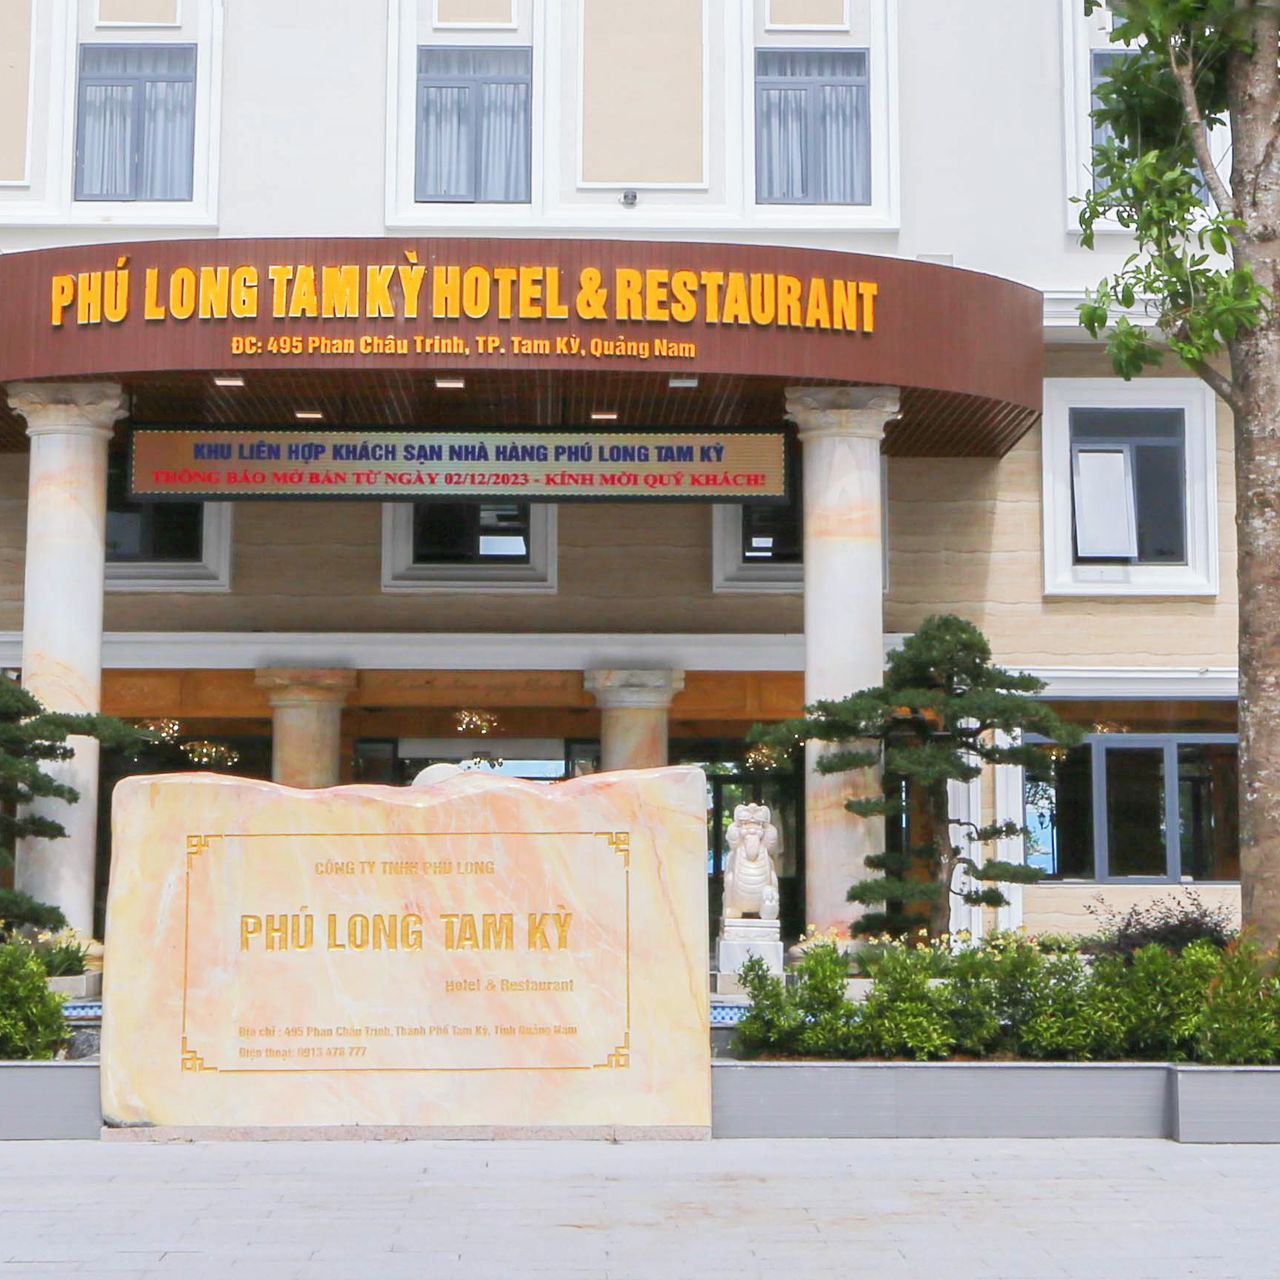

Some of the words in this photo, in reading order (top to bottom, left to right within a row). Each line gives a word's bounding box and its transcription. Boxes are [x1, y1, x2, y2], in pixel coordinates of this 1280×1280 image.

[51, 256, 129, 325] PHÚ
[144, 265, 258, 320] LONG
[432, 266, 569, 320] HOTEL
[576, 267, 609, 320] &
[615, 268, 878, 333] RESTAURANT
[231, 336, 262, 354] ĐC:
[267, 336, 303, 354] 495
[308, 336, 355, 354] Phan
[360, 335, 408, 354] Châu
[413, 335, 470, 355] Trinh,
[476, 336, 505, 354] TP.
[511, 336, 550, 354] Tam
[556, 334, 585, 357] Kỳ,
[590, 335, 649, 359] Quảng
[654, 339, 696, 358] Nam
[194, 443, 231, 460] KHU
[238, 440, 281, 460] LIÊN
[288, 442, 326, 464] HỢP
[332, 441, 396, 461] KHÁCH
[403, 444, 442, 464] SẠN
[449, 441, 489, 462] NHÀ
[495, 441, 548, 462] HÀNG
[554, 442, 592, 462] PHÚ
[598, 445, 649, 462] LONG
[655, 445, 694, 462] TAM
[700, 442, 725, 462] KỲ
[153, 468, 219, 484] THÔNG
[227, 469, 266, 484] BÁO
[309, 470, 346, 484] BÁN
[385, 470, 439, 485] NGÀY
[444, 473, 529, 486] 02/12/2023
[545, 471, 594, 486] KÍNH
[643, 472, 684, 488] QUÝ
[690, 471, 766, 486] KHÁCH!
[315, 859, 355, 875] CÔNG
[360, 861, 376, 875] TY
[381, 861, 418, 875] TNHH
[457, 861, 495, 875] LONG
[240, 905, 314, 952] PHÚ
[327, 913, 422, 952] LONG
[440, 913, 514, 952] TAM
[527, 905, 573, 952] KỲ
[486, 979, 496, 992] &
[500, 978, 574, 992] Restaurant
